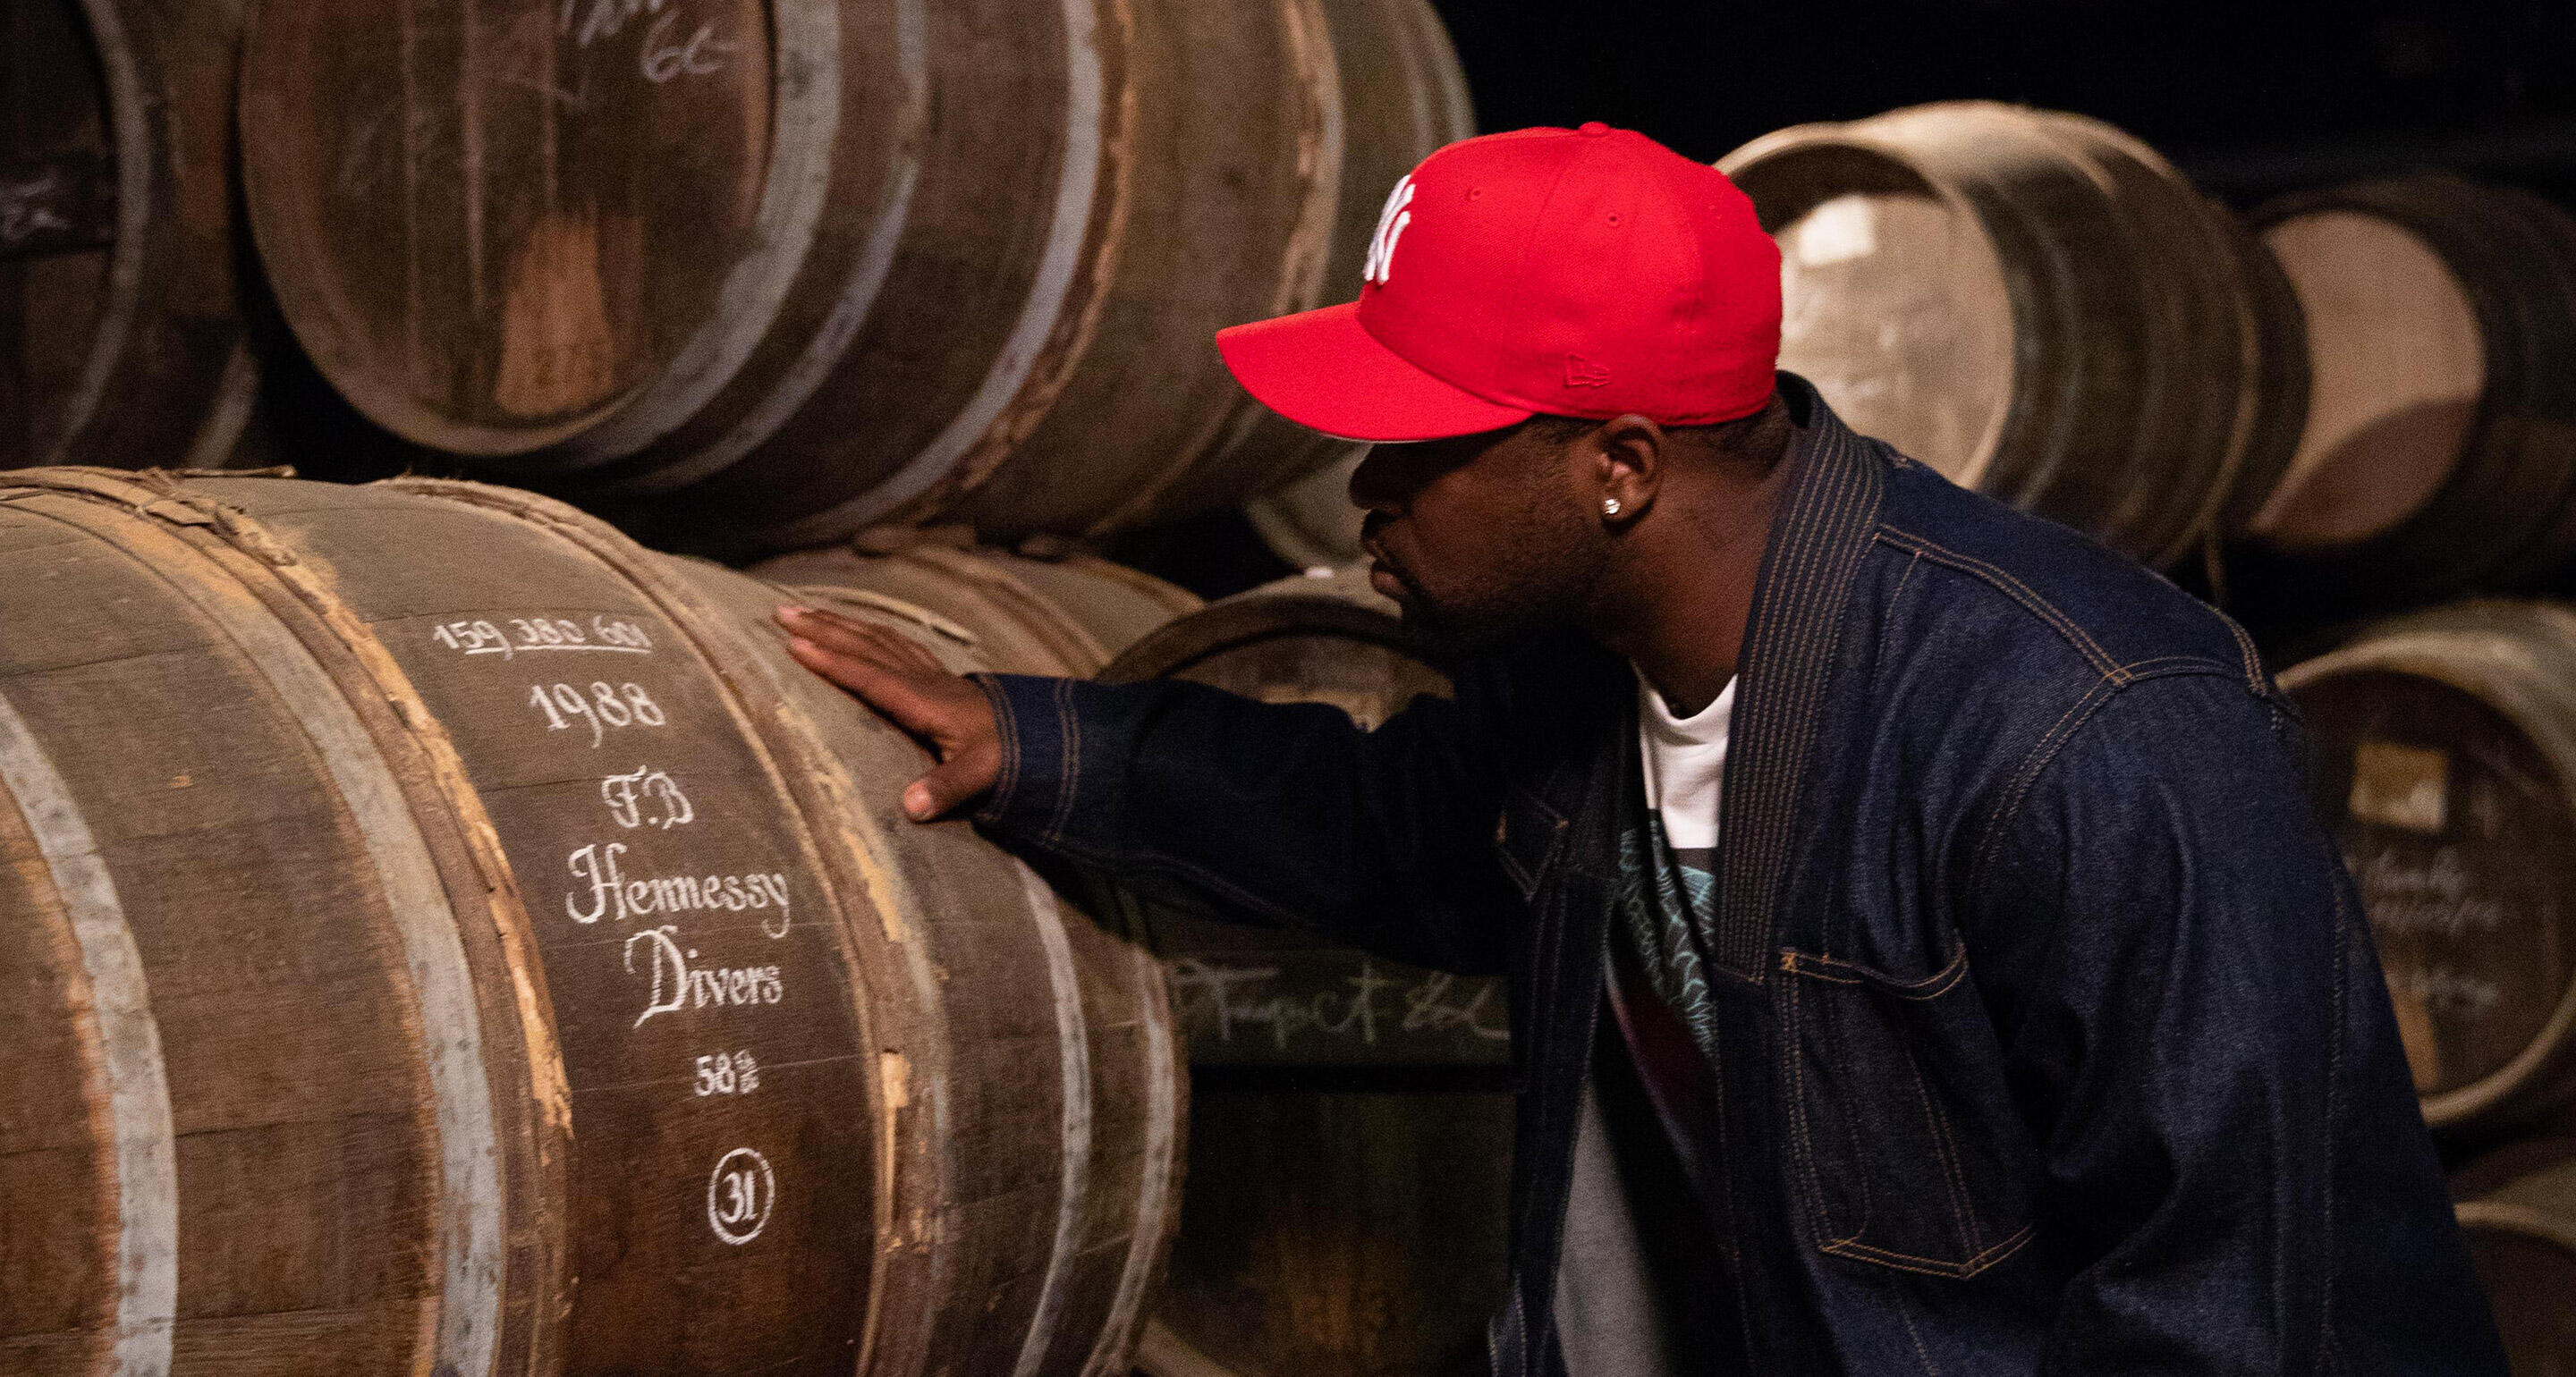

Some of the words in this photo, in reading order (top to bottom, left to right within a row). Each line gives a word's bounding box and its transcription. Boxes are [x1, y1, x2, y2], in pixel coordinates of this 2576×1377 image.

[433, 620, 514, 662] 159
[529, 681, 666, 748] 1988
[565, 842, 791, 939] Hennessy
[623, 925, 784, 1028] Divers
[718, 1170, 758, 1223] 31
